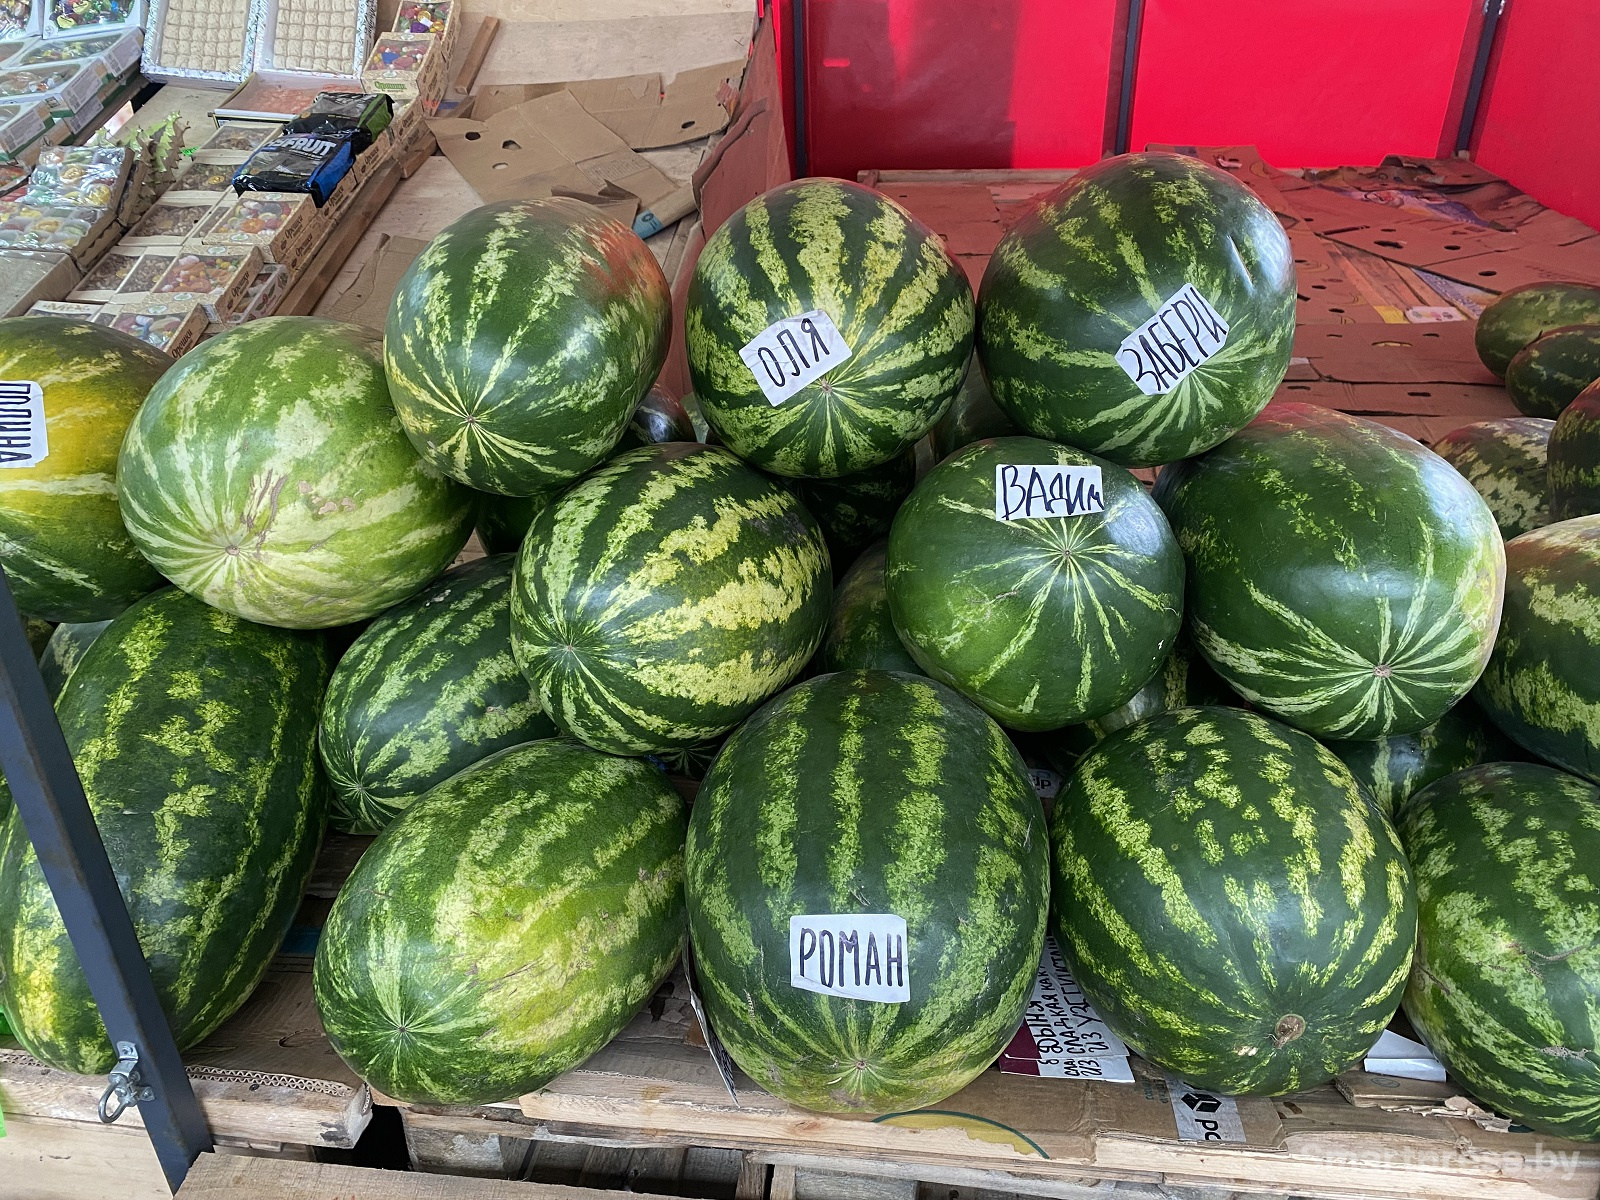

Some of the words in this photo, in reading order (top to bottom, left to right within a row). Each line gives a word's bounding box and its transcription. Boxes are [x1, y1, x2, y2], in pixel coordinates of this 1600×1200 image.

[757, 317, 831, 388] ОЛЯ
[1122, 286, 1228, 392] ЗАБЕРИ
[799, 927, 904, 989] РОМАН
[1041, 993, 1086, 1054] СЛАДКАЯ
[1081, 1031, 1109, 1053] ИЗ
